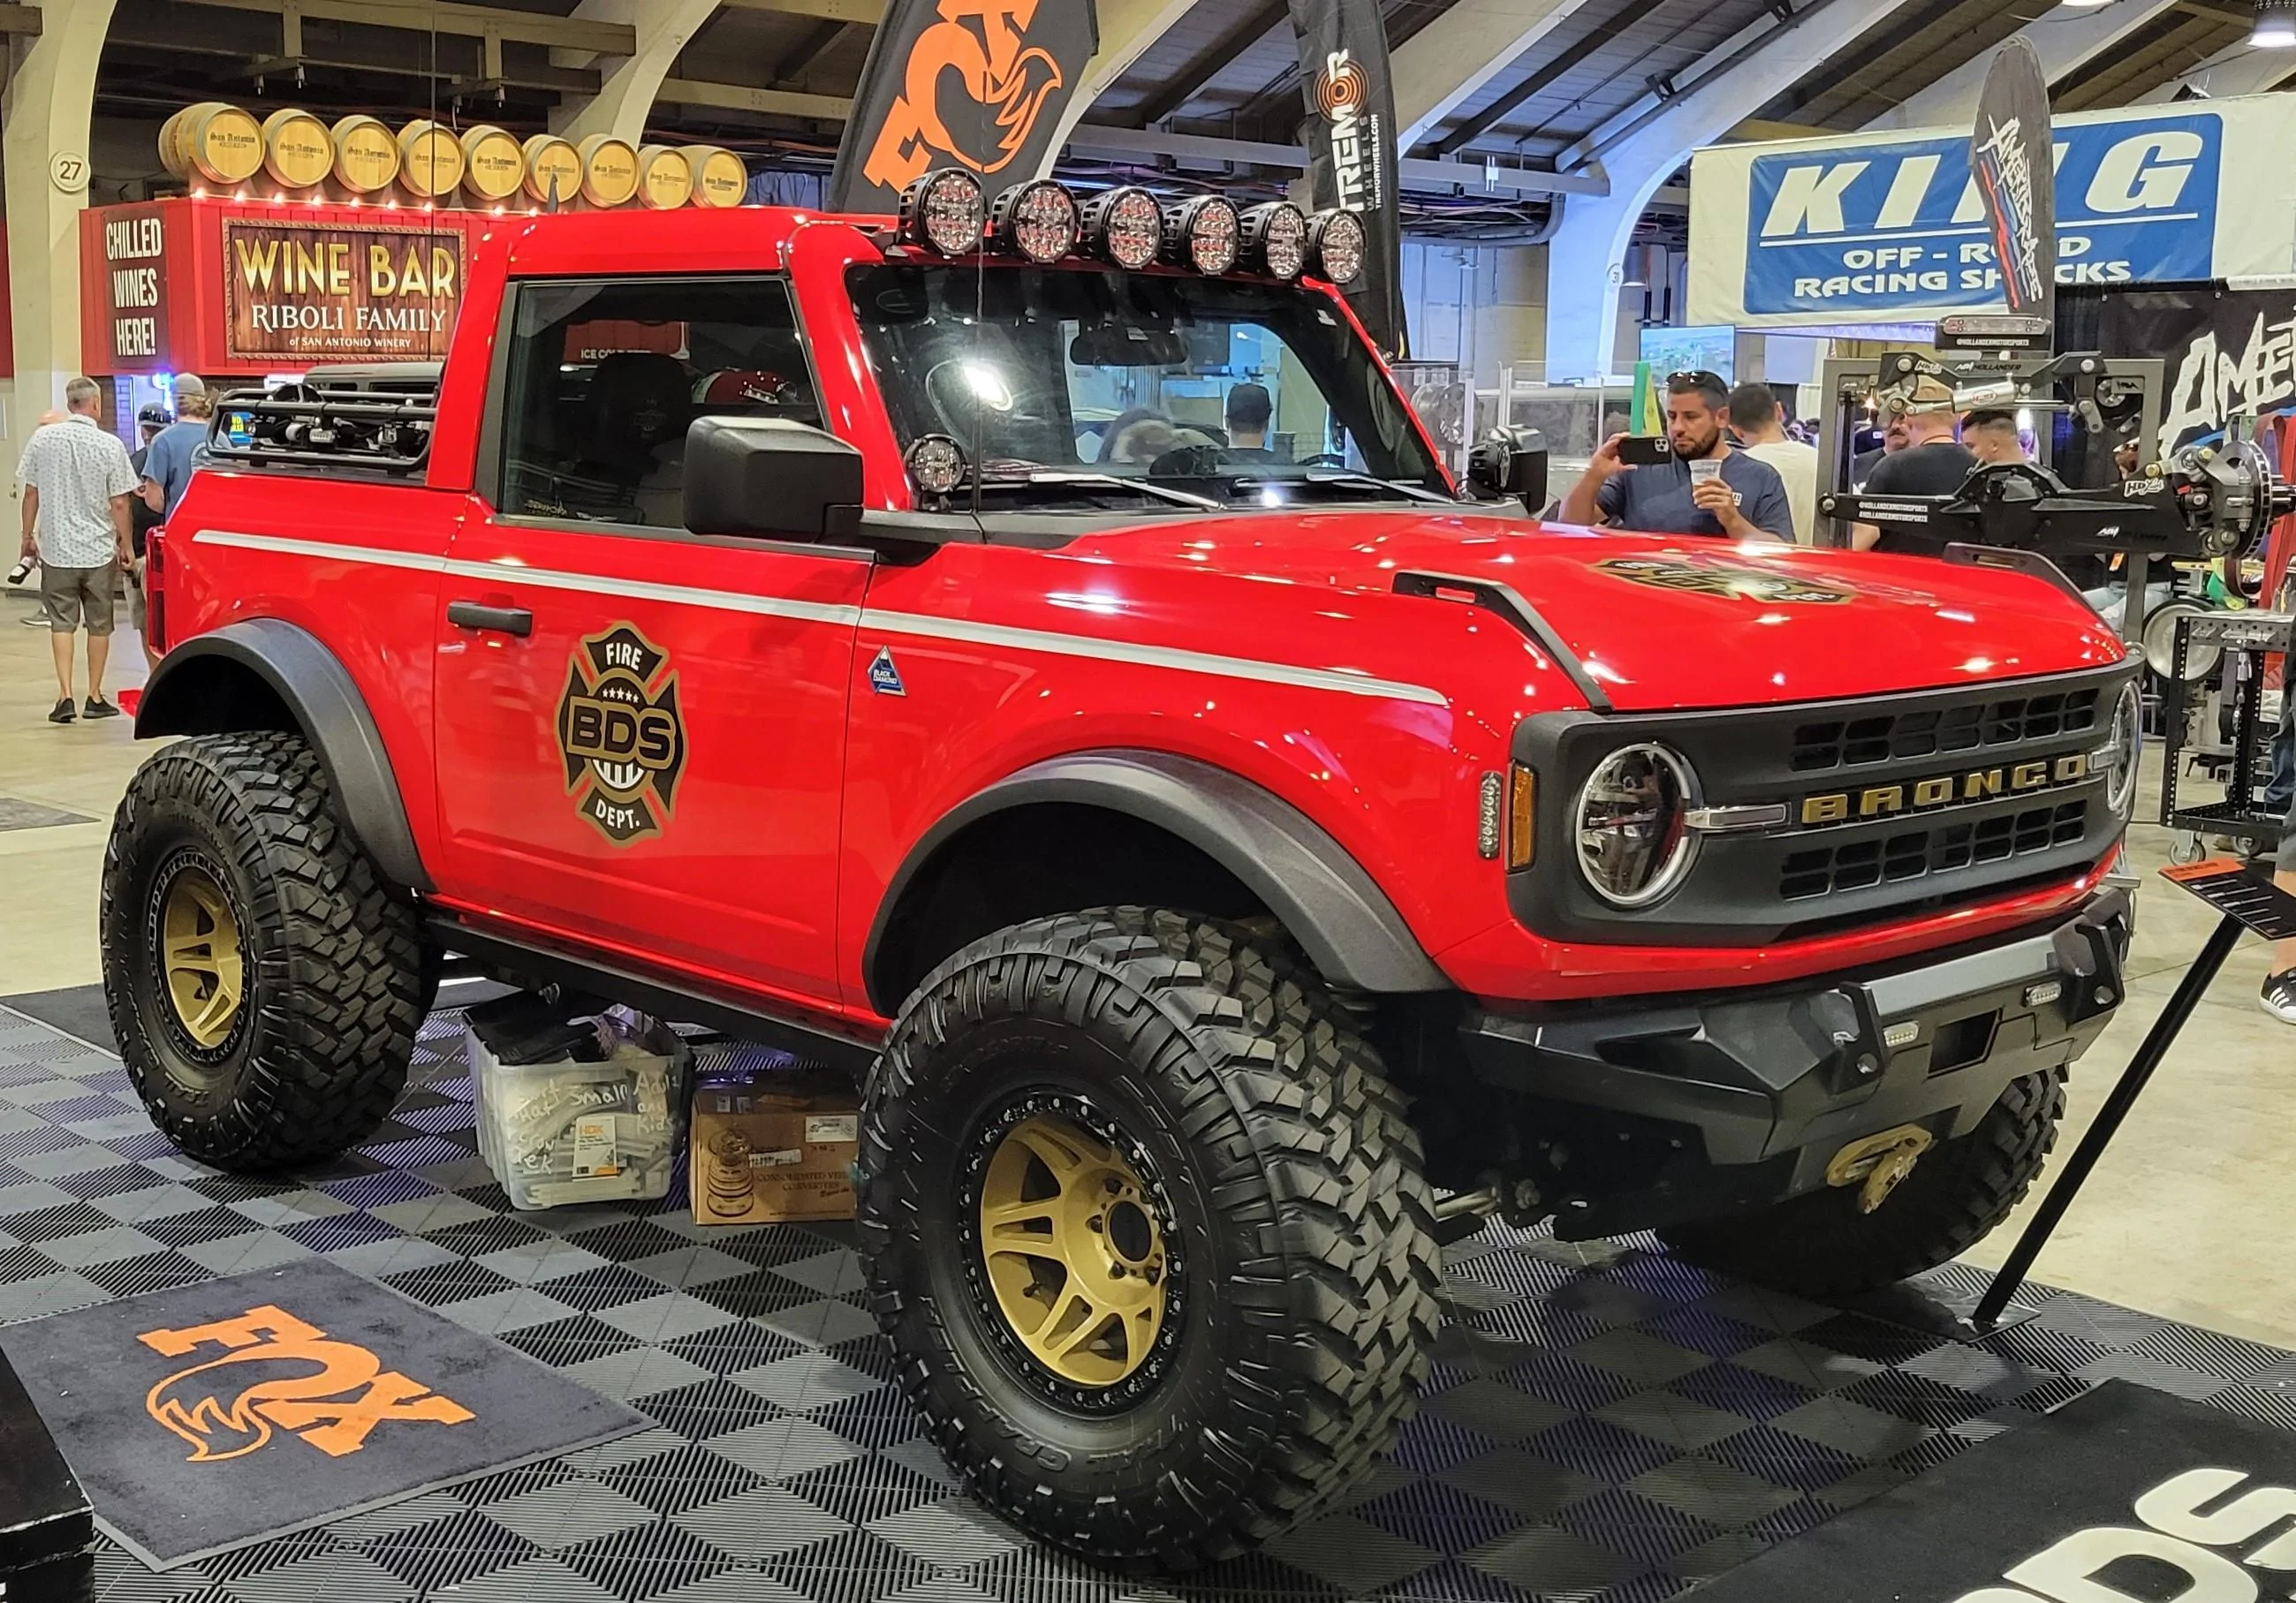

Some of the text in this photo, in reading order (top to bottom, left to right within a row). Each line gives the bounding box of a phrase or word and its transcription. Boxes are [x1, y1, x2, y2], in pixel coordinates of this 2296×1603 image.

[1325, 48, 1366, 212] TREMOR
[58, 160, 82, 181] 27
[1359, 116, 1375, 212] WHEELS
[1370, 113, 1383, 210] TREMORWHEELS.COM
[106, 217, 163, 261] CHILLED
[1843, 246, 1924, 270] OFF
[1959, 236, 2092, 265] RD
[113, 268, 159, 308] WINES
[235, 238, 456, 299] WINE BAR
[1793, 261, 2132, 299] RACING SHCKS
[115, 317, 156, 357] HERE!
[251, 304, 447, 334] RIBOLI FAMILY
[289, 337, 412, 347] of SAN ANTONIO WINERY
[580, 348, 597, 359] ICE
[605, 642, 643, 671] FIRE
[567, 696, 676, 769] BDS
[1800, 753, 2087, 824] BRONCO
[595, 798, 640, 829] DEPT.
[135, 1304, 477, 1463] FOX
[1948, 1467, 2296, 1603] DS
